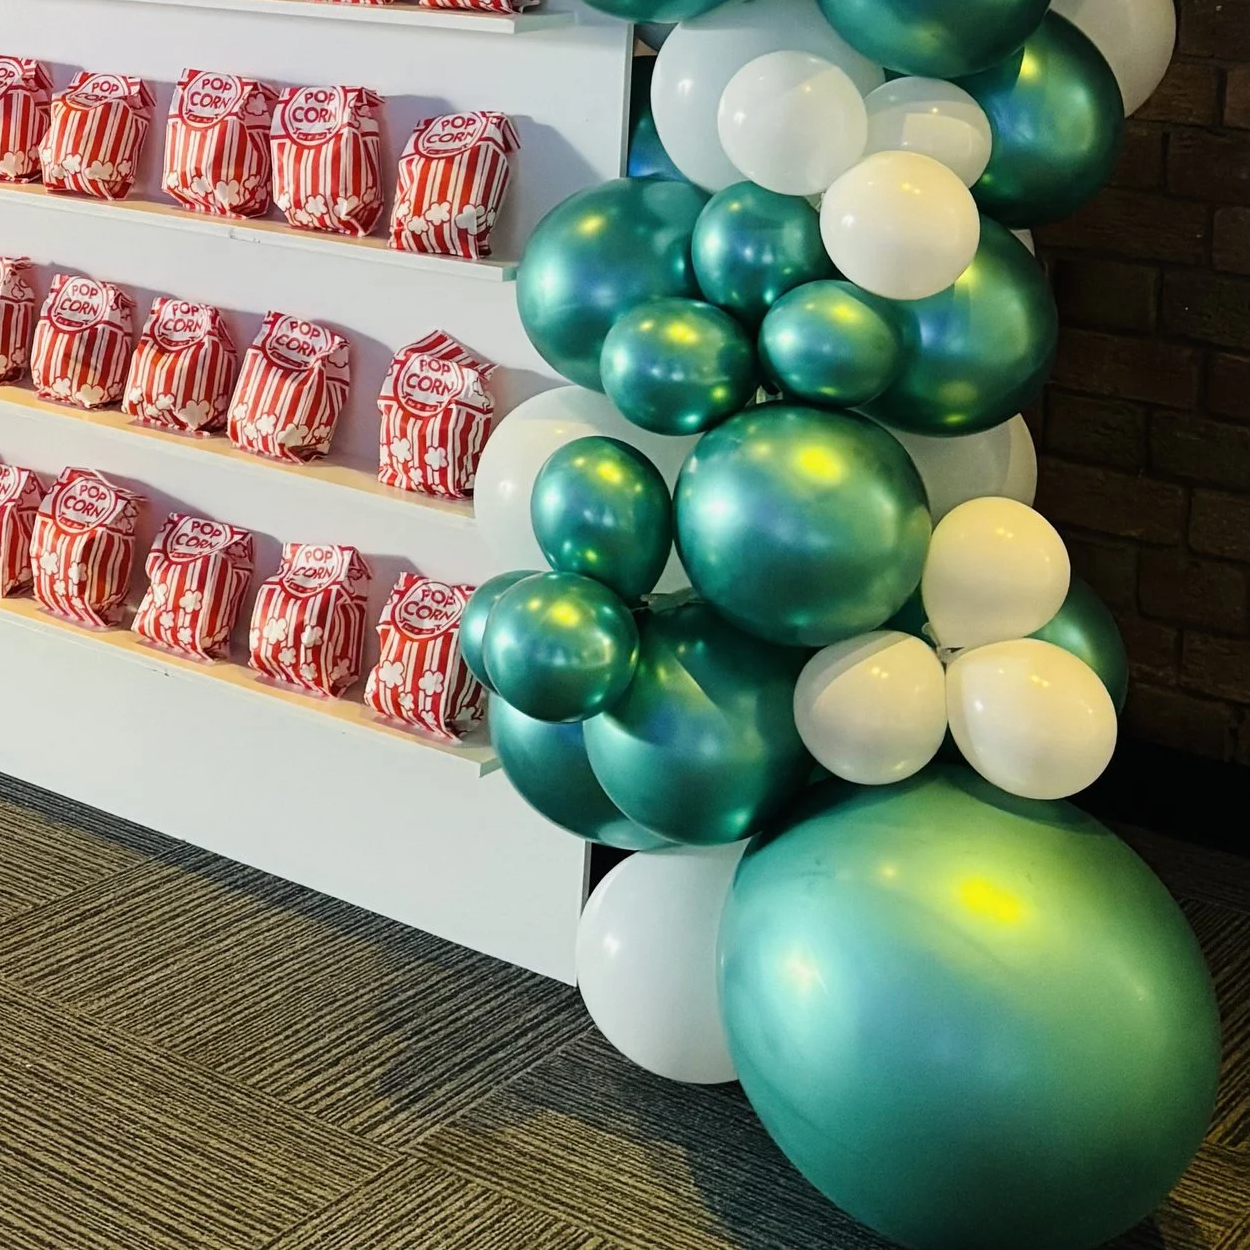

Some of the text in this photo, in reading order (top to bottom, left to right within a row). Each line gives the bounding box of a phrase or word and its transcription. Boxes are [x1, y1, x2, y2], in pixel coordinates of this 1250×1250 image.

[91, 81, 119, 94] POP
[202, 78, 232, 92] POP
[190, 91, 231, 108] CORN
[304, 90, 335, 103] POP
[292, 107, 336, 123] CORN
[440, 116, 476, 130] POP
[427, 128, 474, 143] CORN
[72, 284, 98, 298] POP
[60, 299, 98, 316] CORN
[172, 302, 199, 316] POP
[162, 319, 203, 332] CORN
[289, 321, 321, 339] POP
[275, 332, 323, 358] CORN
[419, 359, 450, 375] POP
[406, 373, 454, 397] CORN
[79, 484, 107, 502] POP
[64, 495, 104, 518] CORN
[191, 520, 222, 537] POP
[175, 535, 217, 549] CORN
[304, 548, 333, 563] POP
[294, 566, 334, 578] CORN
[421, 589, 456, 607] POP
[404, 600, 453, 620] CORN
